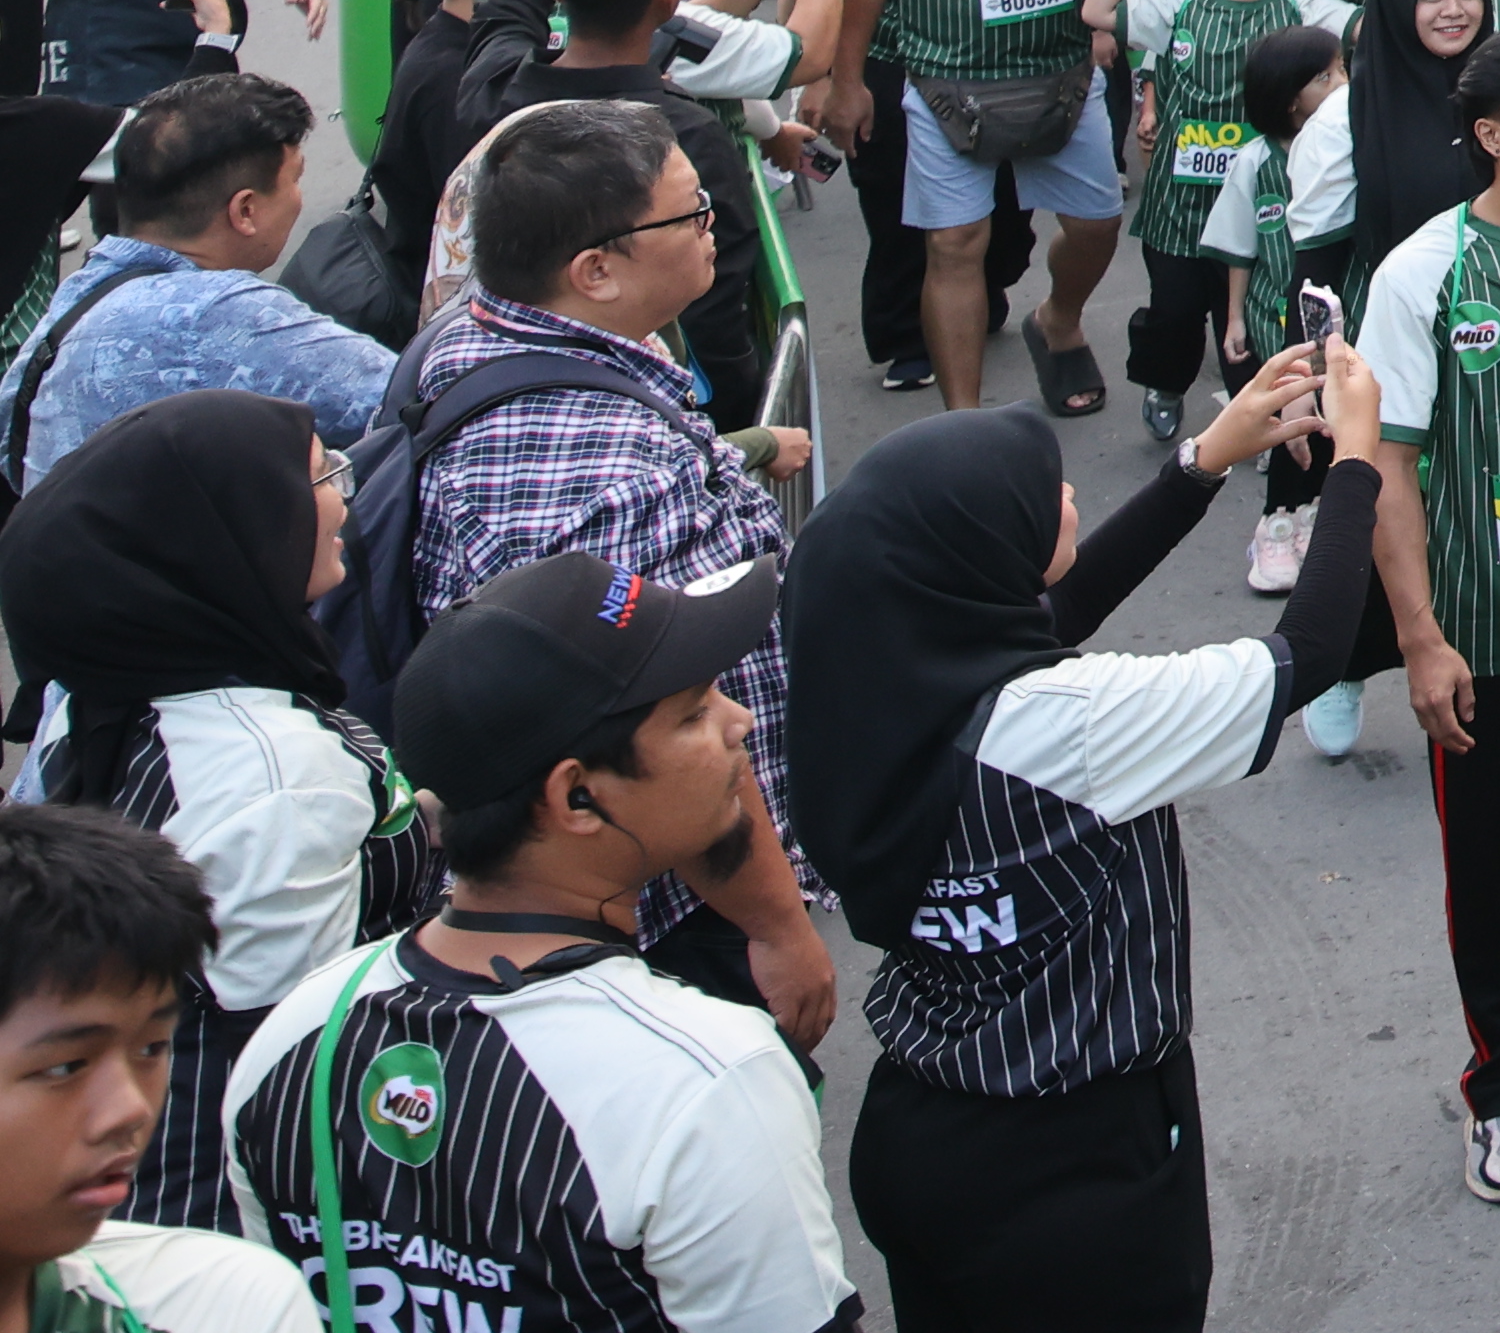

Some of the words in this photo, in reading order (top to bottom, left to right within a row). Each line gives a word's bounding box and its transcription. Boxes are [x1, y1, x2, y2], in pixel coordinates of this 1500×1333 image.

[1175, 123, 1243, 152] MILO
[1452, 329, 1496, 345] MILO
[385, 1089, 431, 1122] MILO
[280, 1210, 324, 1245] TH
